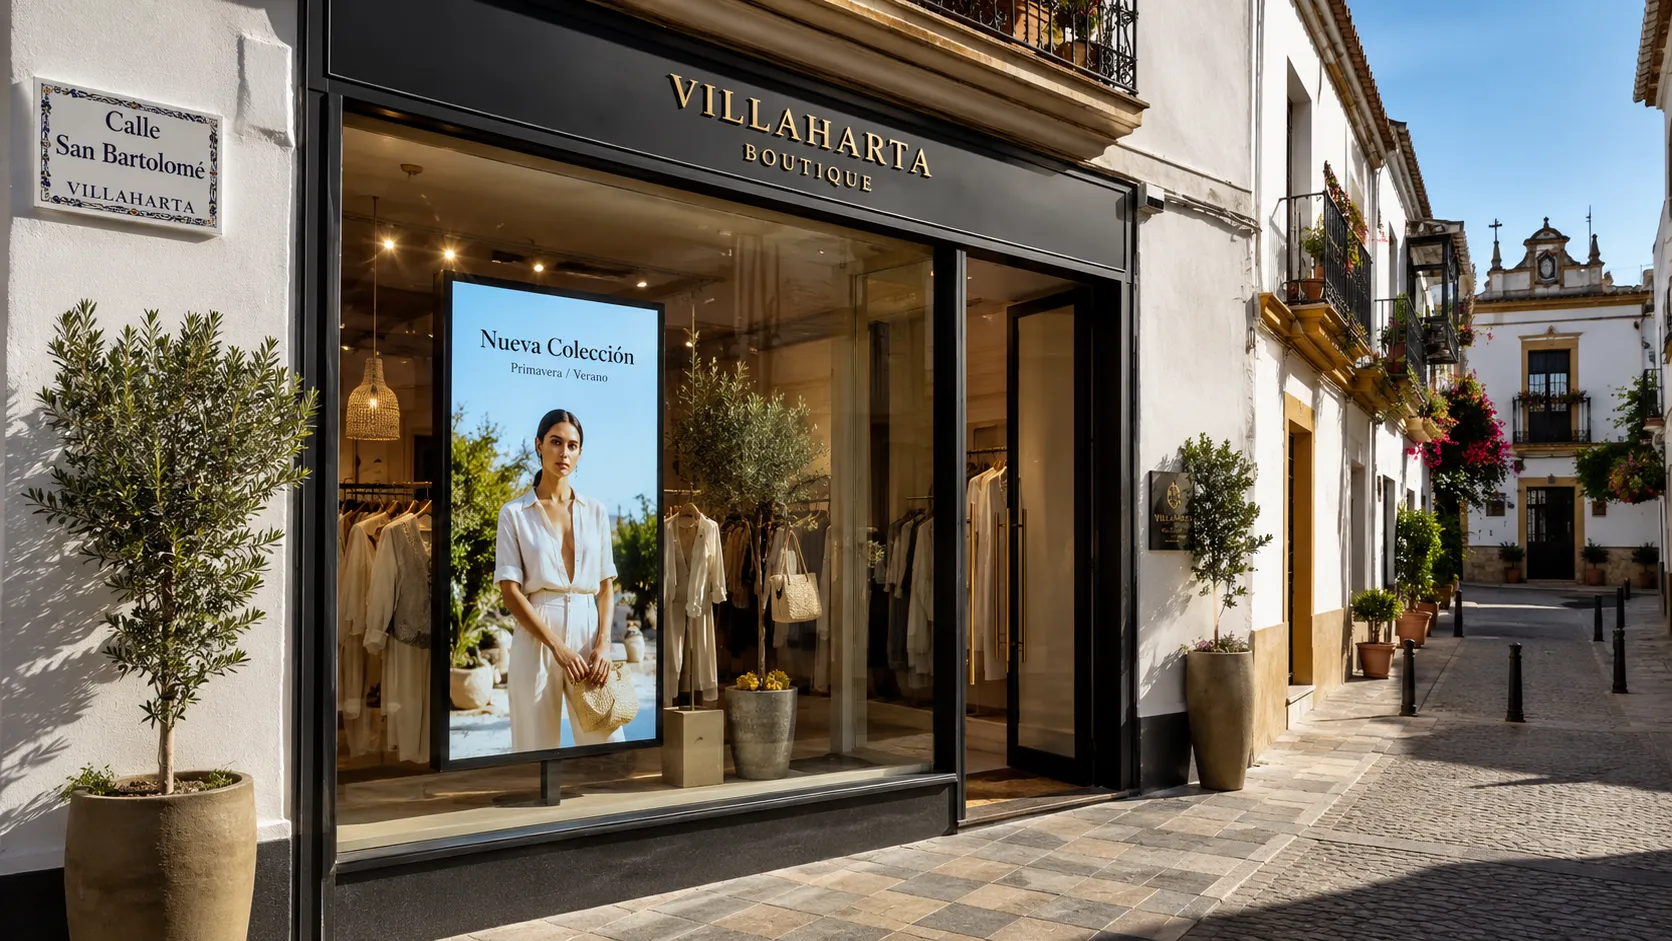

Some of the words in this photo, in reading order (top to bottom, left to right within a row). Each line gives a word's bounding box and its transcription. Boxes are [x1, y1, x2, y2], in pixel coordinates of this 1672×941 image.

[105, 111, 161, 140] Calle
[667, 73, 932, 178] VILLAHARTA
[56, 134, 96, 161] San
[102, 142, 205, 180] Bartolomé
[743, 144, 872, 192] BOUTIQUE
[67, 181, 195, 215] VILLAHARTA
[480, 329, 542, 355] Nueva
[547, 338, 635, 366] Colección
[510, 362, 563, 379] Primavera
[565, 368, 571, 379] /
[573, 368, 608, 383] Verano
